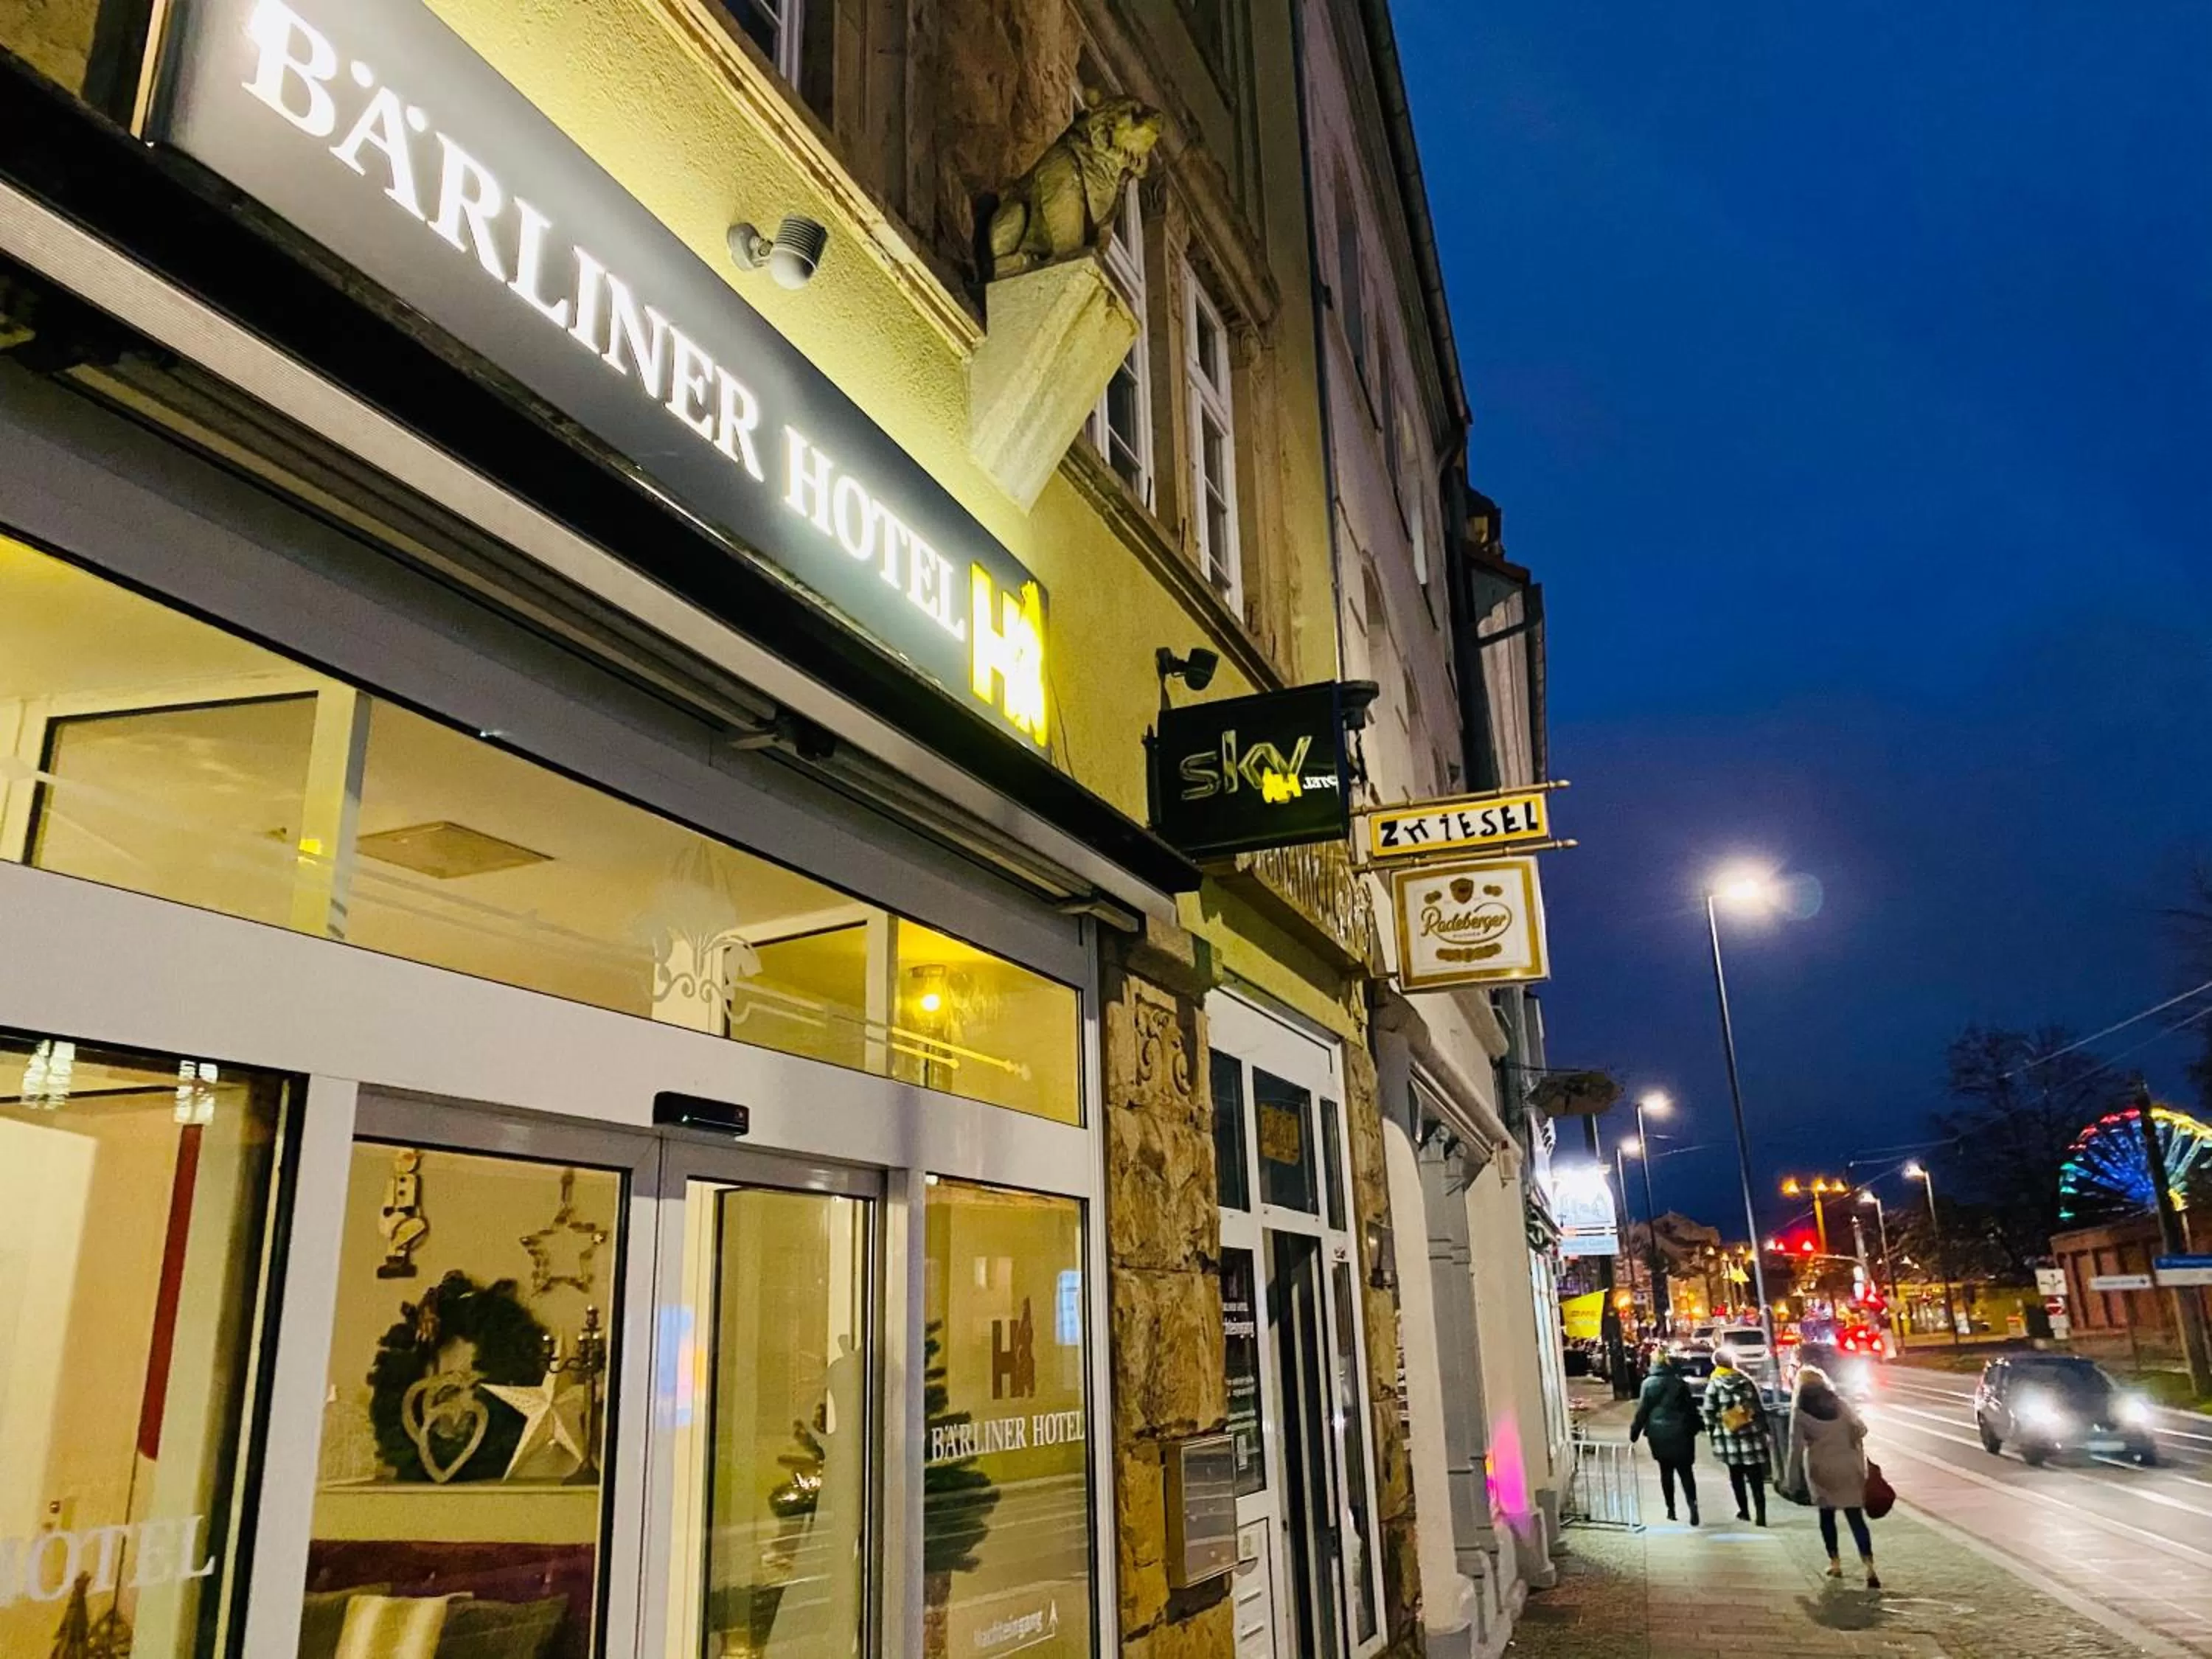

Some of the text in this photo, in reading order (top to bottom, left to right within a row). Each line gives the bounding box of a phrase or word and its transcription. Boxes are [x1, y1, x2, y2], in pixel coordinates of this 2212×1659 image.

[241, 0, 966, 644] BÄRLINER HOTEL
[1180, 729, 1312, 804] sky
[1421, 904, 1509, 939] Radeberger
[931, 1411, 1085, 1463] BÄRLINER HOTEL
